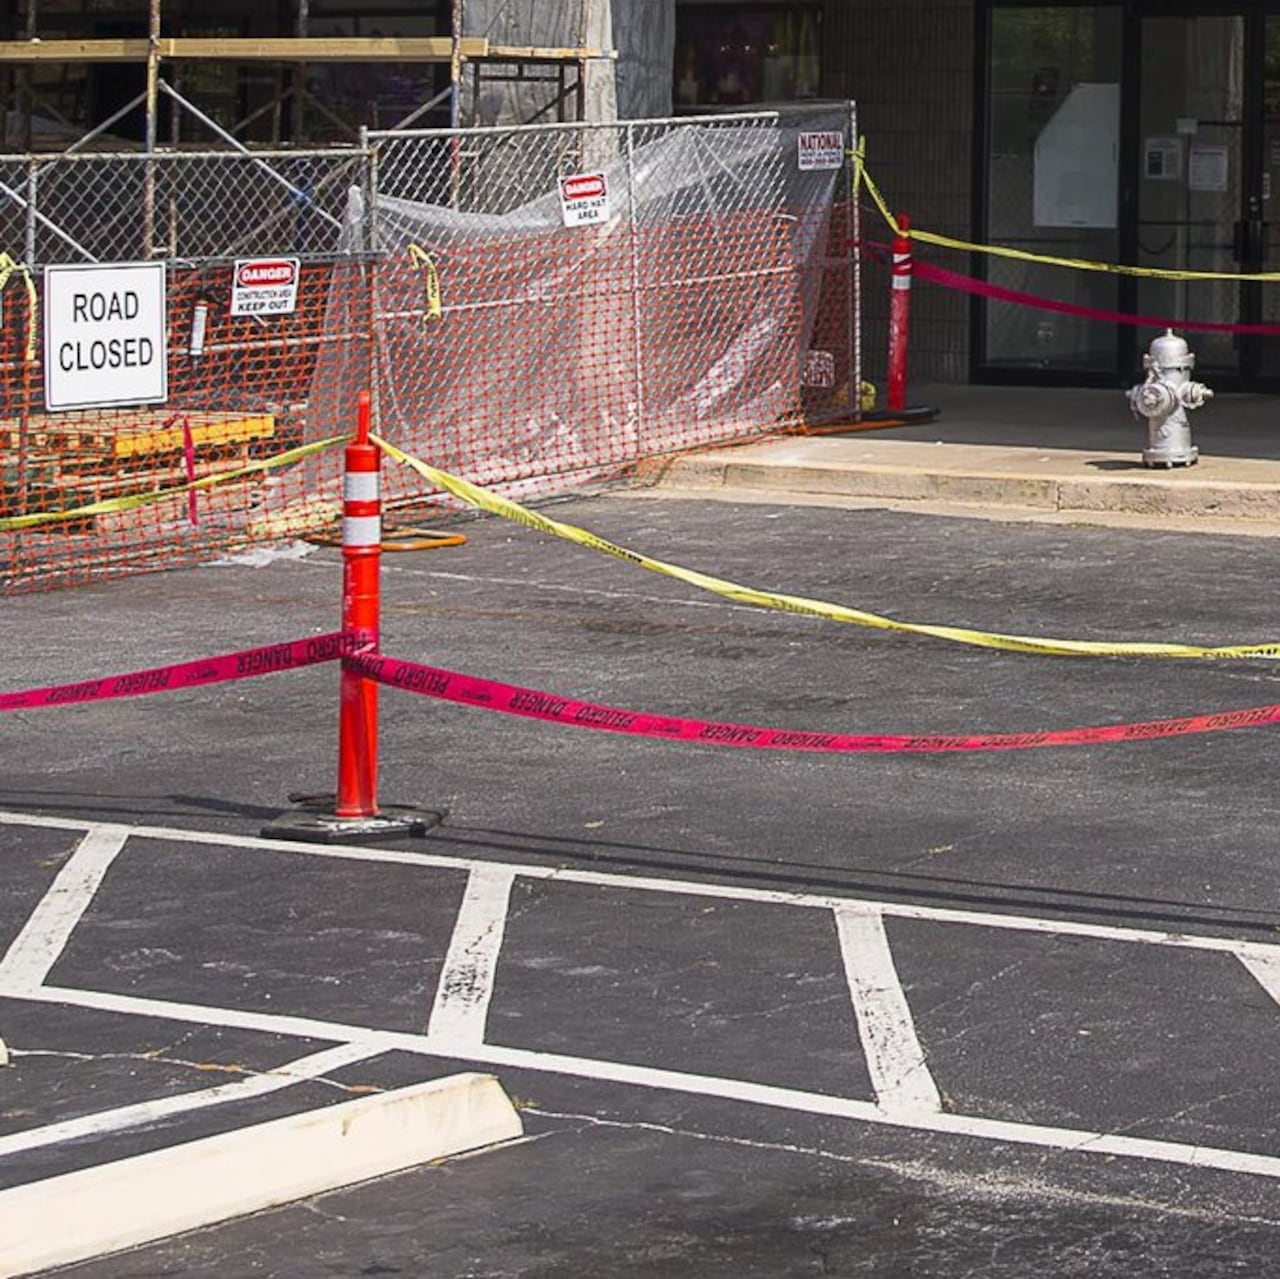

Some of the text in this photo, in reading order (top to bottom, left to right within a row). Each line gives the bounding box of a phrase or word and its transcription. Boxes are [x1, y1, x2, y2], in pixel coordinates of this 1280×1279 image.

[241, 266, 292, 282] DANGER
[72, 291, 140, 323] ROAD
[238, 300, 289, 312] KEEP OUT
[59, 337, 153, 372] CLOSED
[237, 642, 292, 673] DANGER
[394, 663, 450, 695] PELIGRO
[508, 690, 568, 717] DANGER
[700, 723, 759, 744] DANGER
